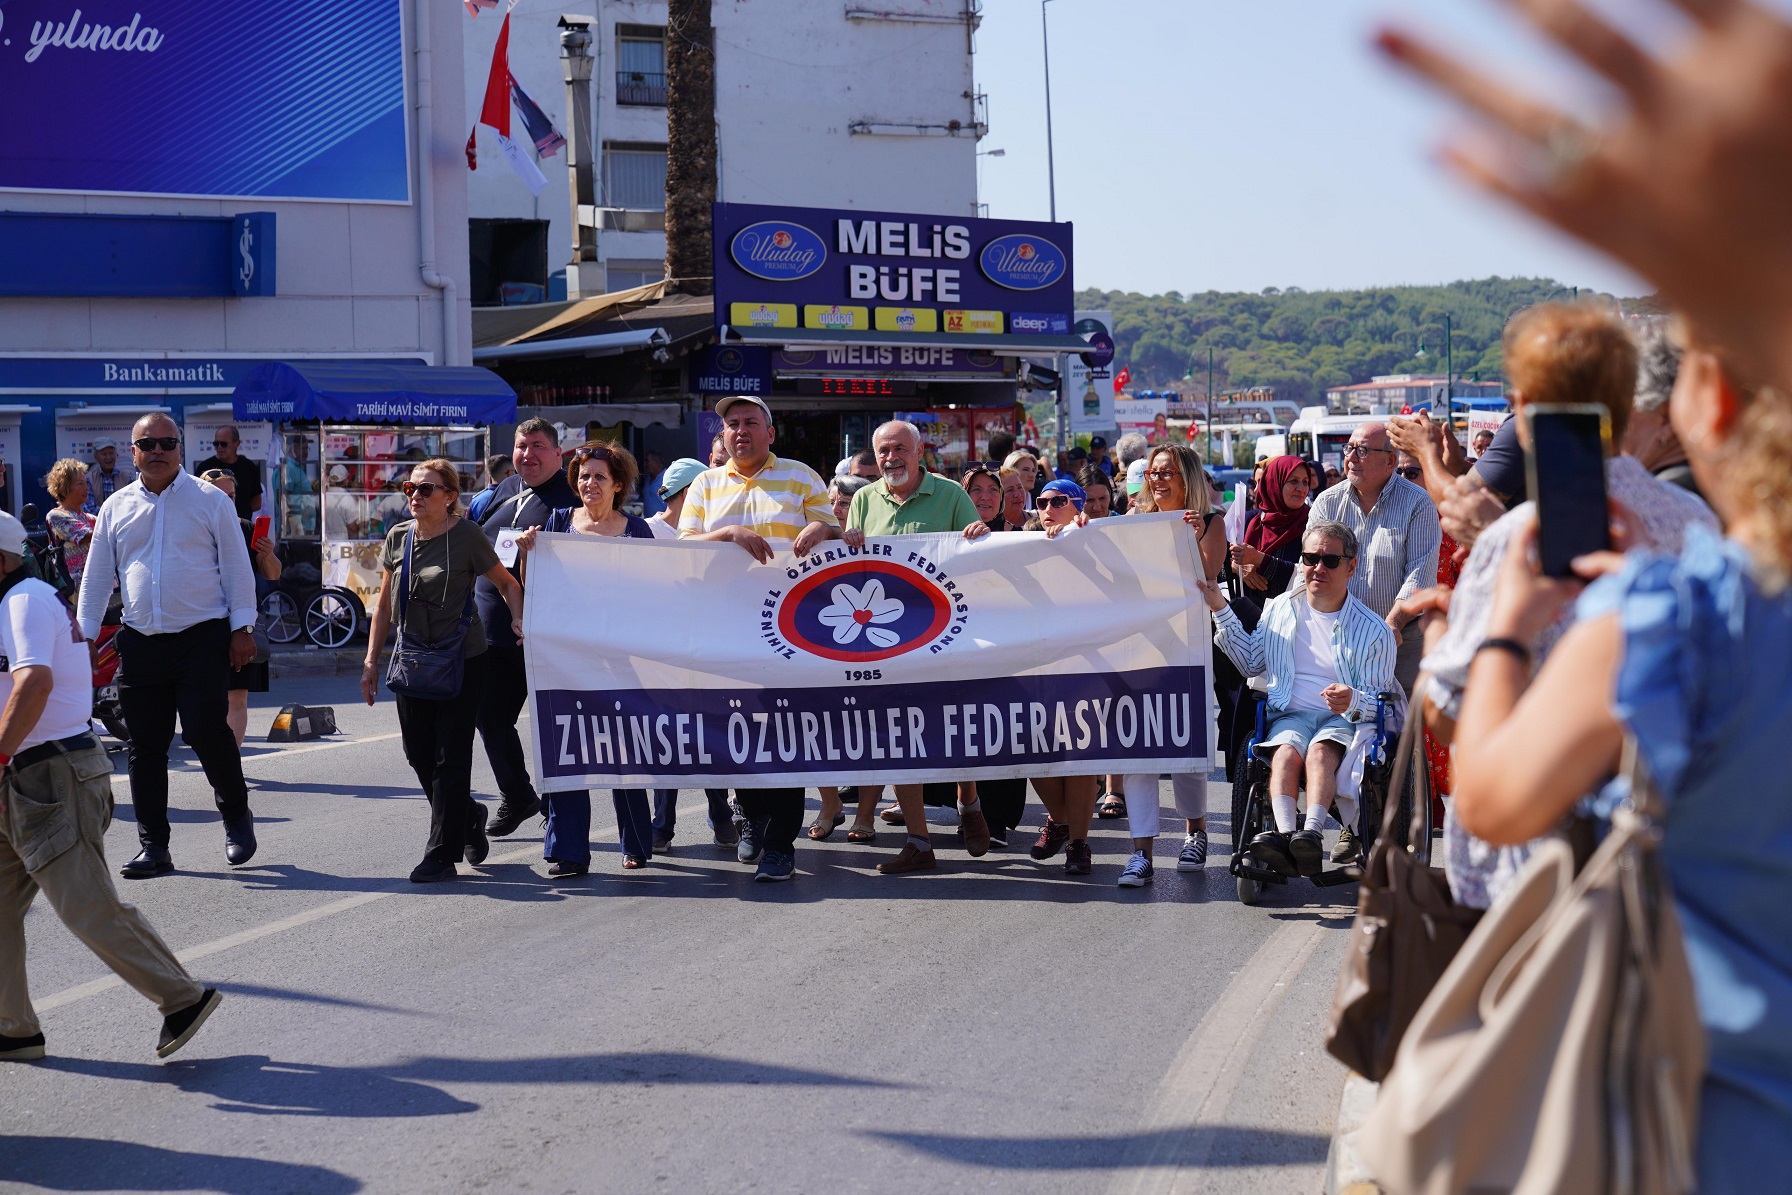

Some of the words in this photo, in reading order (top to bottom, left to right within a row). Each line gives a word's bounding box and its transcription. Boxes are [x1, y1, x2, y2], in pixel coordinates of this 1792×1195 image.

[24, 8, 165, 63] yılında
[740, 231, 817, 274] Uludağ
[764, 261, 797, 270] PREMIUM
[988, 244, 1057, 284] Uludağ
[850, 264, 961, 303] BÜFE
[1009, 272, 1039, 280] PREMIUM
[818, 311, 854, 327] uludağ
[947, 316, 963, 327] AZ
[1012, 316, 1048, 332] deep
[103, 363, 225, 382] Bankamatik
[733, 374, 760, 391] BÜFE
[356, 401, 388, 415] TARİHİ
[388, 402, 412, 416] MAVİ
[412, 402, 439, 417] SİMİT
[440, 405, 467, 417] FIRINI
[760, 588, 797, 660] ZİHİNSEL
[907, 551, 968, 655] FEDERASYONU
[844, 669, 882, 681] 1985
[555, 700, 713, 766] ZİHİNSEL
[727, 696, 928, 765] ÖZÜRLÜLER
[942, 692, 1191, 758] FEDERASYONU
